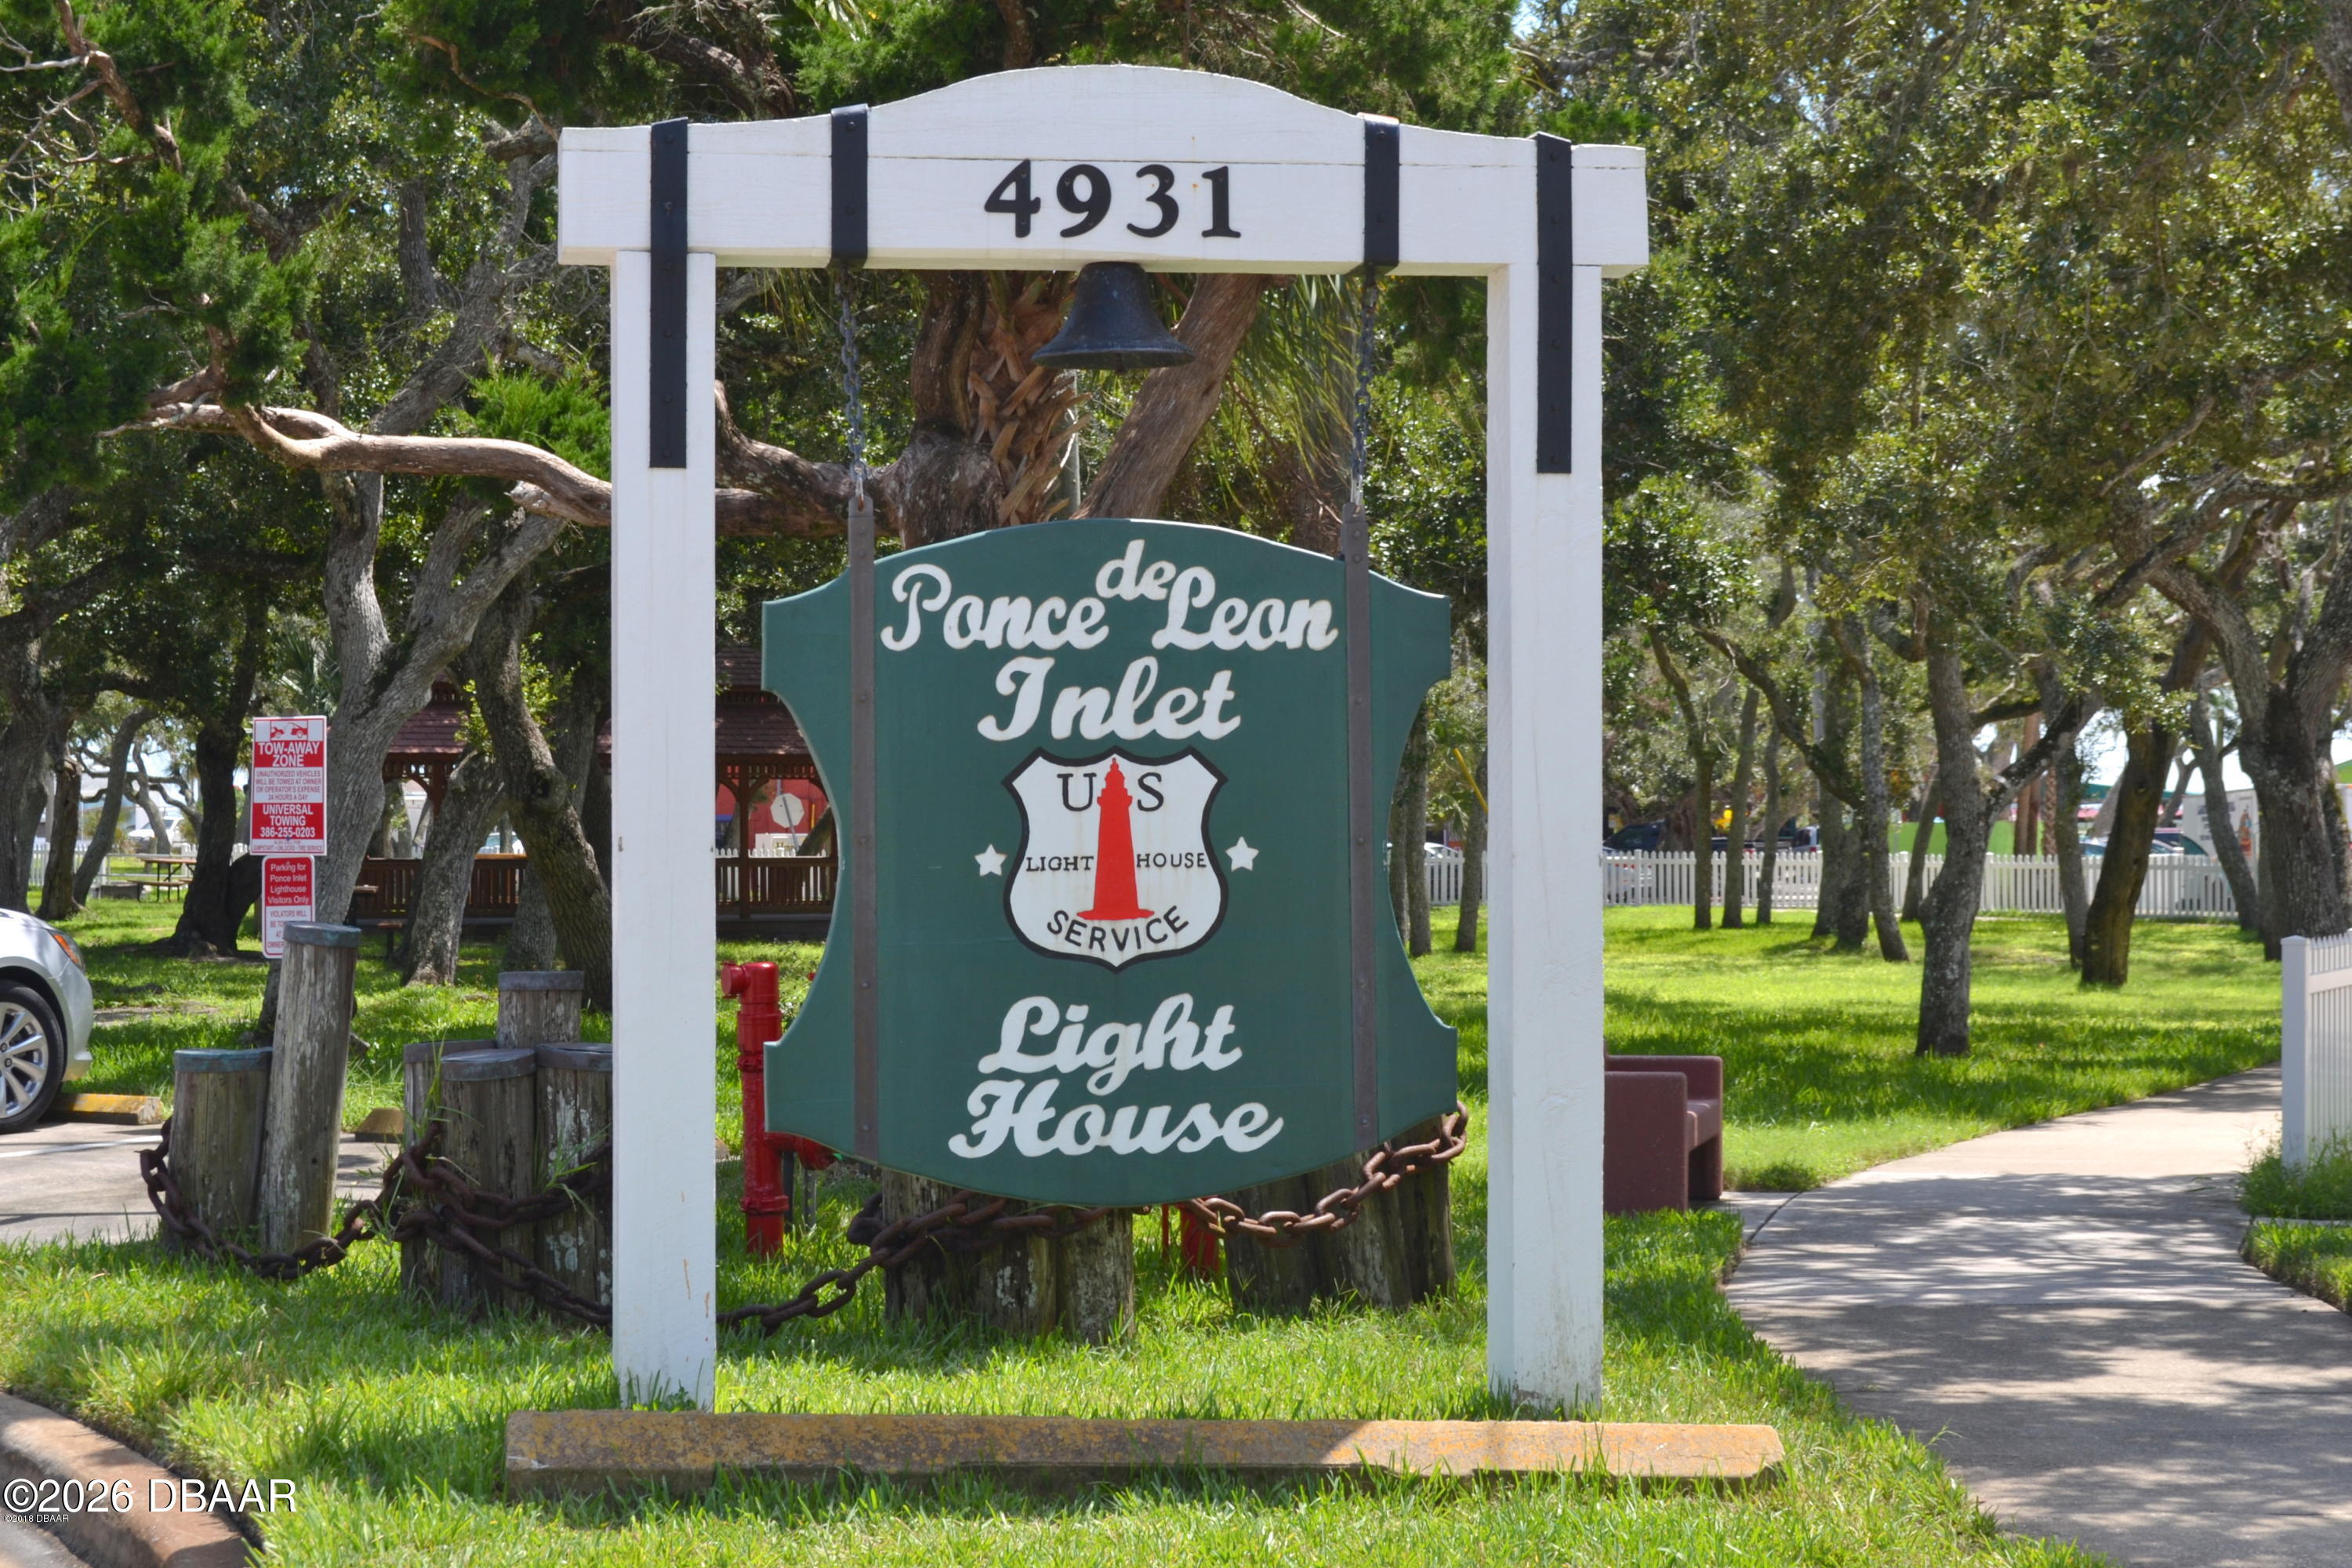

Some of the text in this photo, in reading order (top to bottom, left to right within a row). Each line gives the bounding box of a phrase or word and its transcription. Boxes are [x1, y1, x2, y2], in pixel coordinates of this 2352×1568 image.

[984, 158, 1242, 238] 4931
[880, 539, 1339, 652] Ponce de Leon
[977, 656, 1242, 741] Inlet
[258, 742, 320, 754] TOW-AWAY
[272, 754, 304, 767] ZONE
[263, 804, 314, 815] UNIVERSAL
[270, 815, 306, 826] TOWING
[260, 827, 315, 837] 386-255-0203
[270, 863, 296, 873] Parking
[1025, 852, 1207, 872] LIGHT HOUSE
[292, 873, 307, 882] Inlet
[270, 885, 307, 895] Lighthouse
[293, 895, 309, 905] Only
[1047, 905, 1189, 953] SERVICE
[978, 993, 1243, 1096] Light
[947, 1078, 1284, 1159] House
